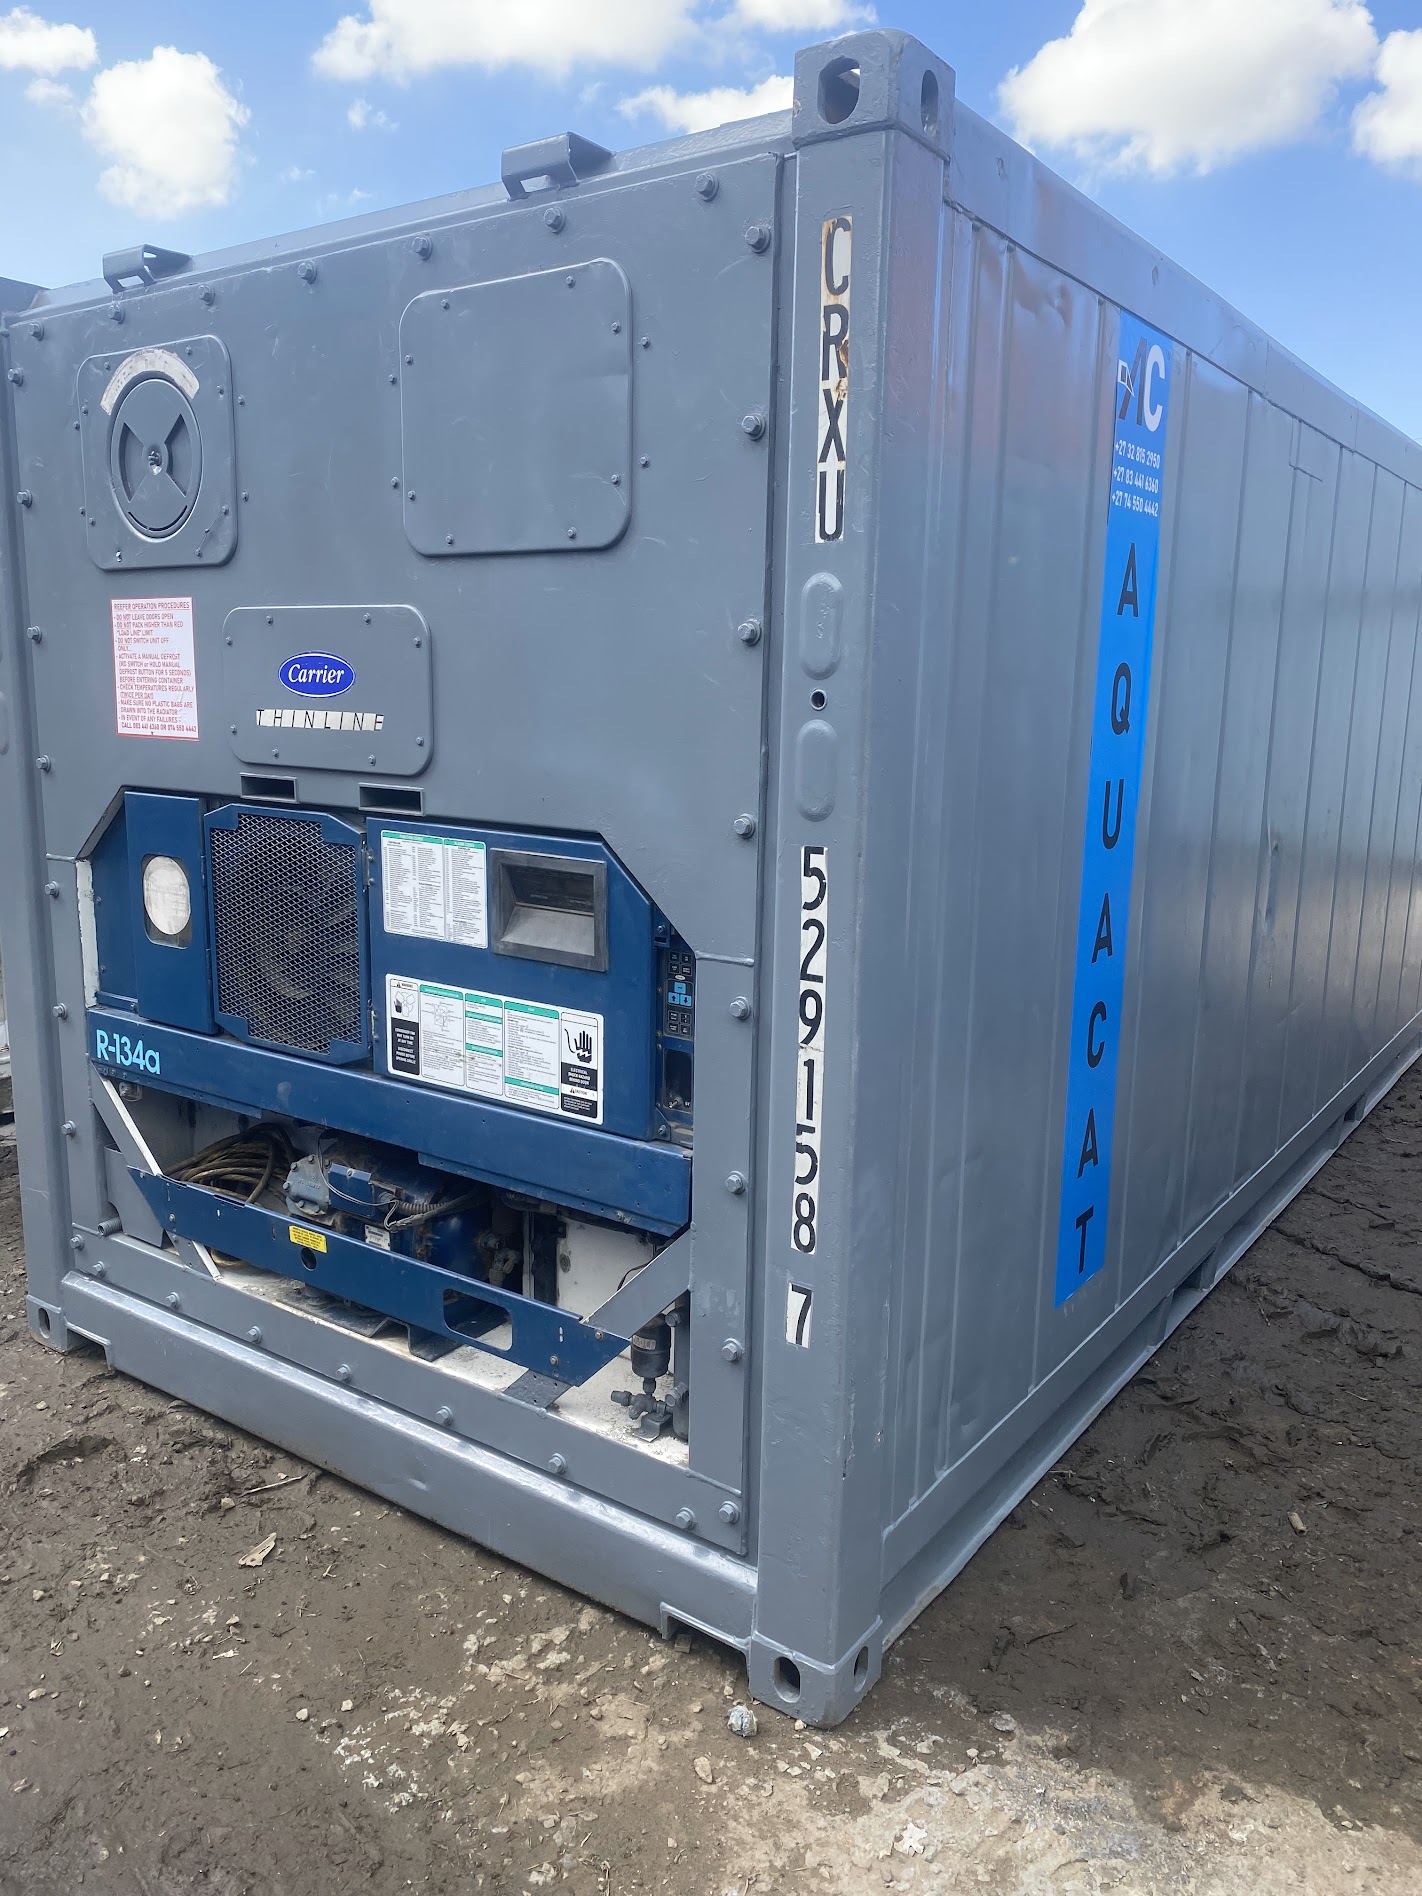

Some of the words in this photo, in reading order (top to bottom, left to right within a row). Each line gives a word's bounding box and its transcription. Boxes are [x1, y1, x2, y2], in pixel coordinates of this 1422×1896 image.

[821, 218, 851, 541] CRXU
[1115, 440, 1127, 456] +27
[1127, 443, 1135, 459] 32
[1135, 445, 1146, 464] 815
[1147, 449, 1160, 469] 2950
[1114, 465, 1125, 482] +27
[1126, 469, 1133, 486] 83
[1134, 472, 1144, 490] 441
[1145, 475, 1158, 494] 6360
[1112, 489, 1123, 507] +27
[1124, 493, 1131, 510] 74
[1132, 495, 1143, 512] 550
[1144, 499, 1158, 517] 4442
[288, 664, 345, 684] Carrier
[257, 709, 384, 731] THINLINE
[1075, 543, 1139, 1275] AQUACAT
[96, 1029, 160, 1075] R-134a
[797, 846, 826, 1254] 529158
[791, 1284, 812, 1346] 7
